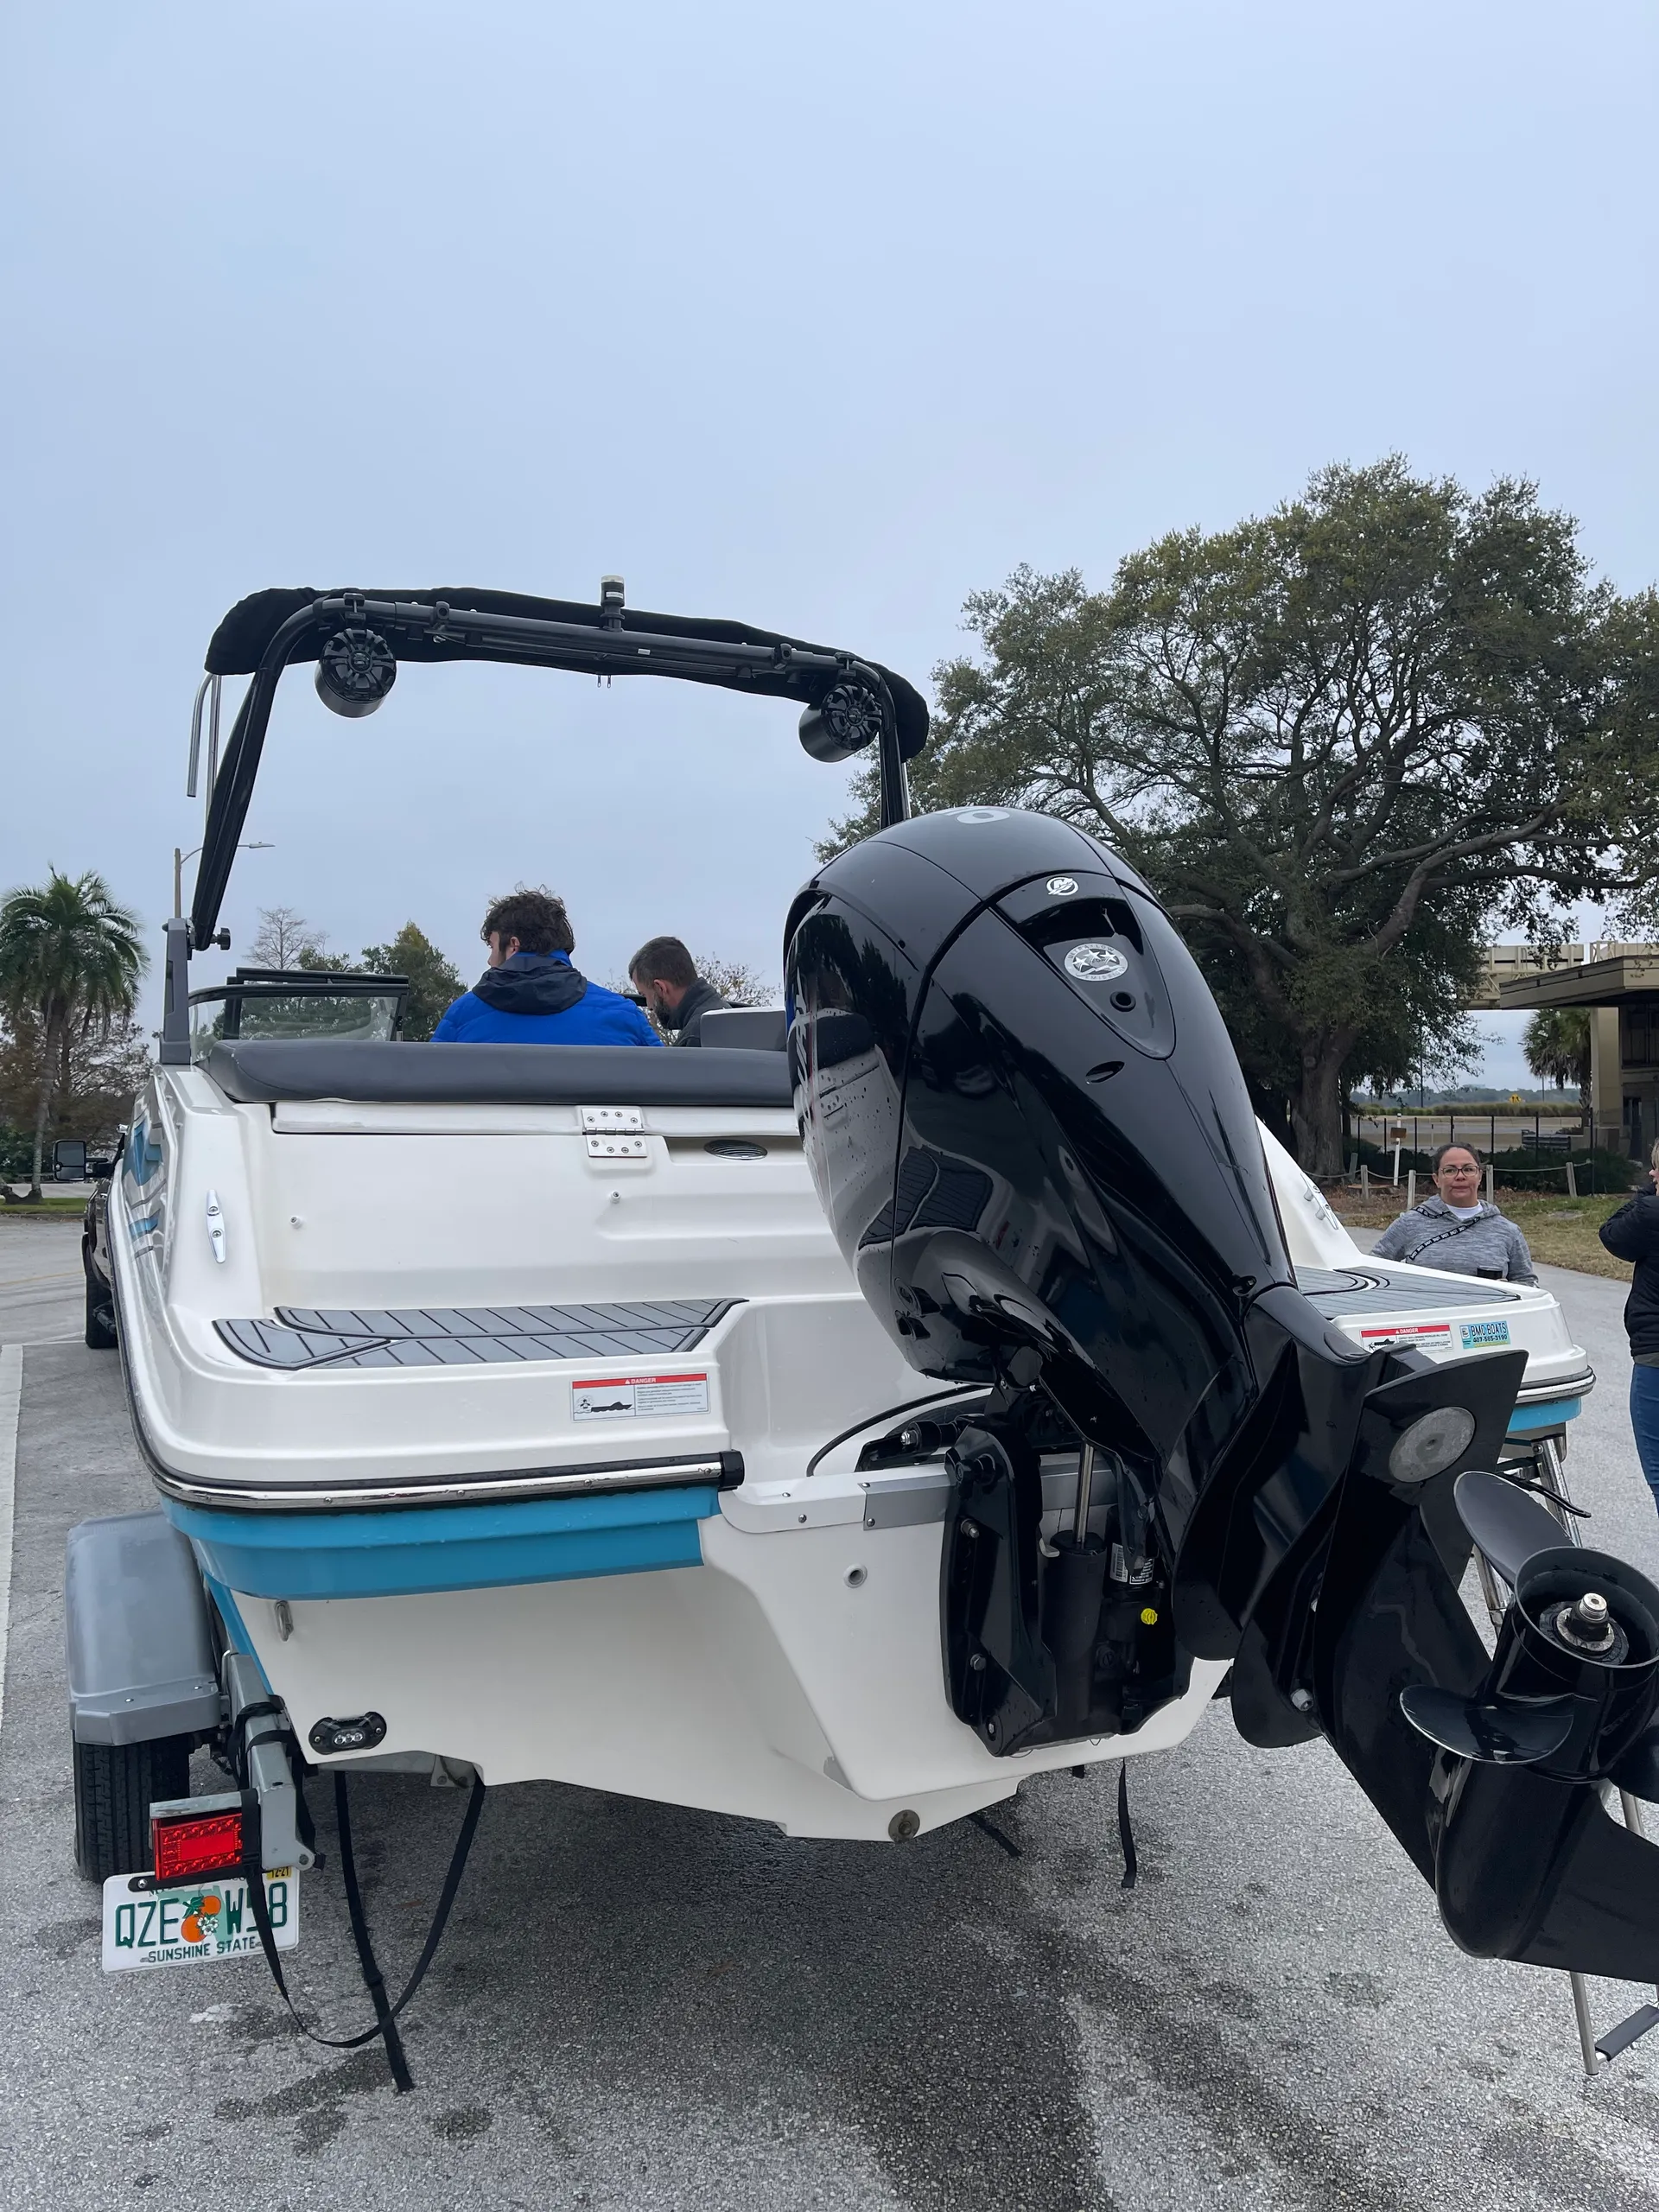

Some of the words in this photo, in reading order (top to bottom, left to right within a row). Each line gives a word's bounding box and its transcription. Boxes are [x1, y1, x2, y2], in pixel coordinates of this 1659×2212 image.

[1471, 1324, 1485, 1336] BMC
[1487, 1322, 1507, 1335] BOATS
[115, 1897, 180, 1949] QZE
[148, 1943, 211, 1964] SUNSHINE
[216, 1936, 256, 1954] STATE
